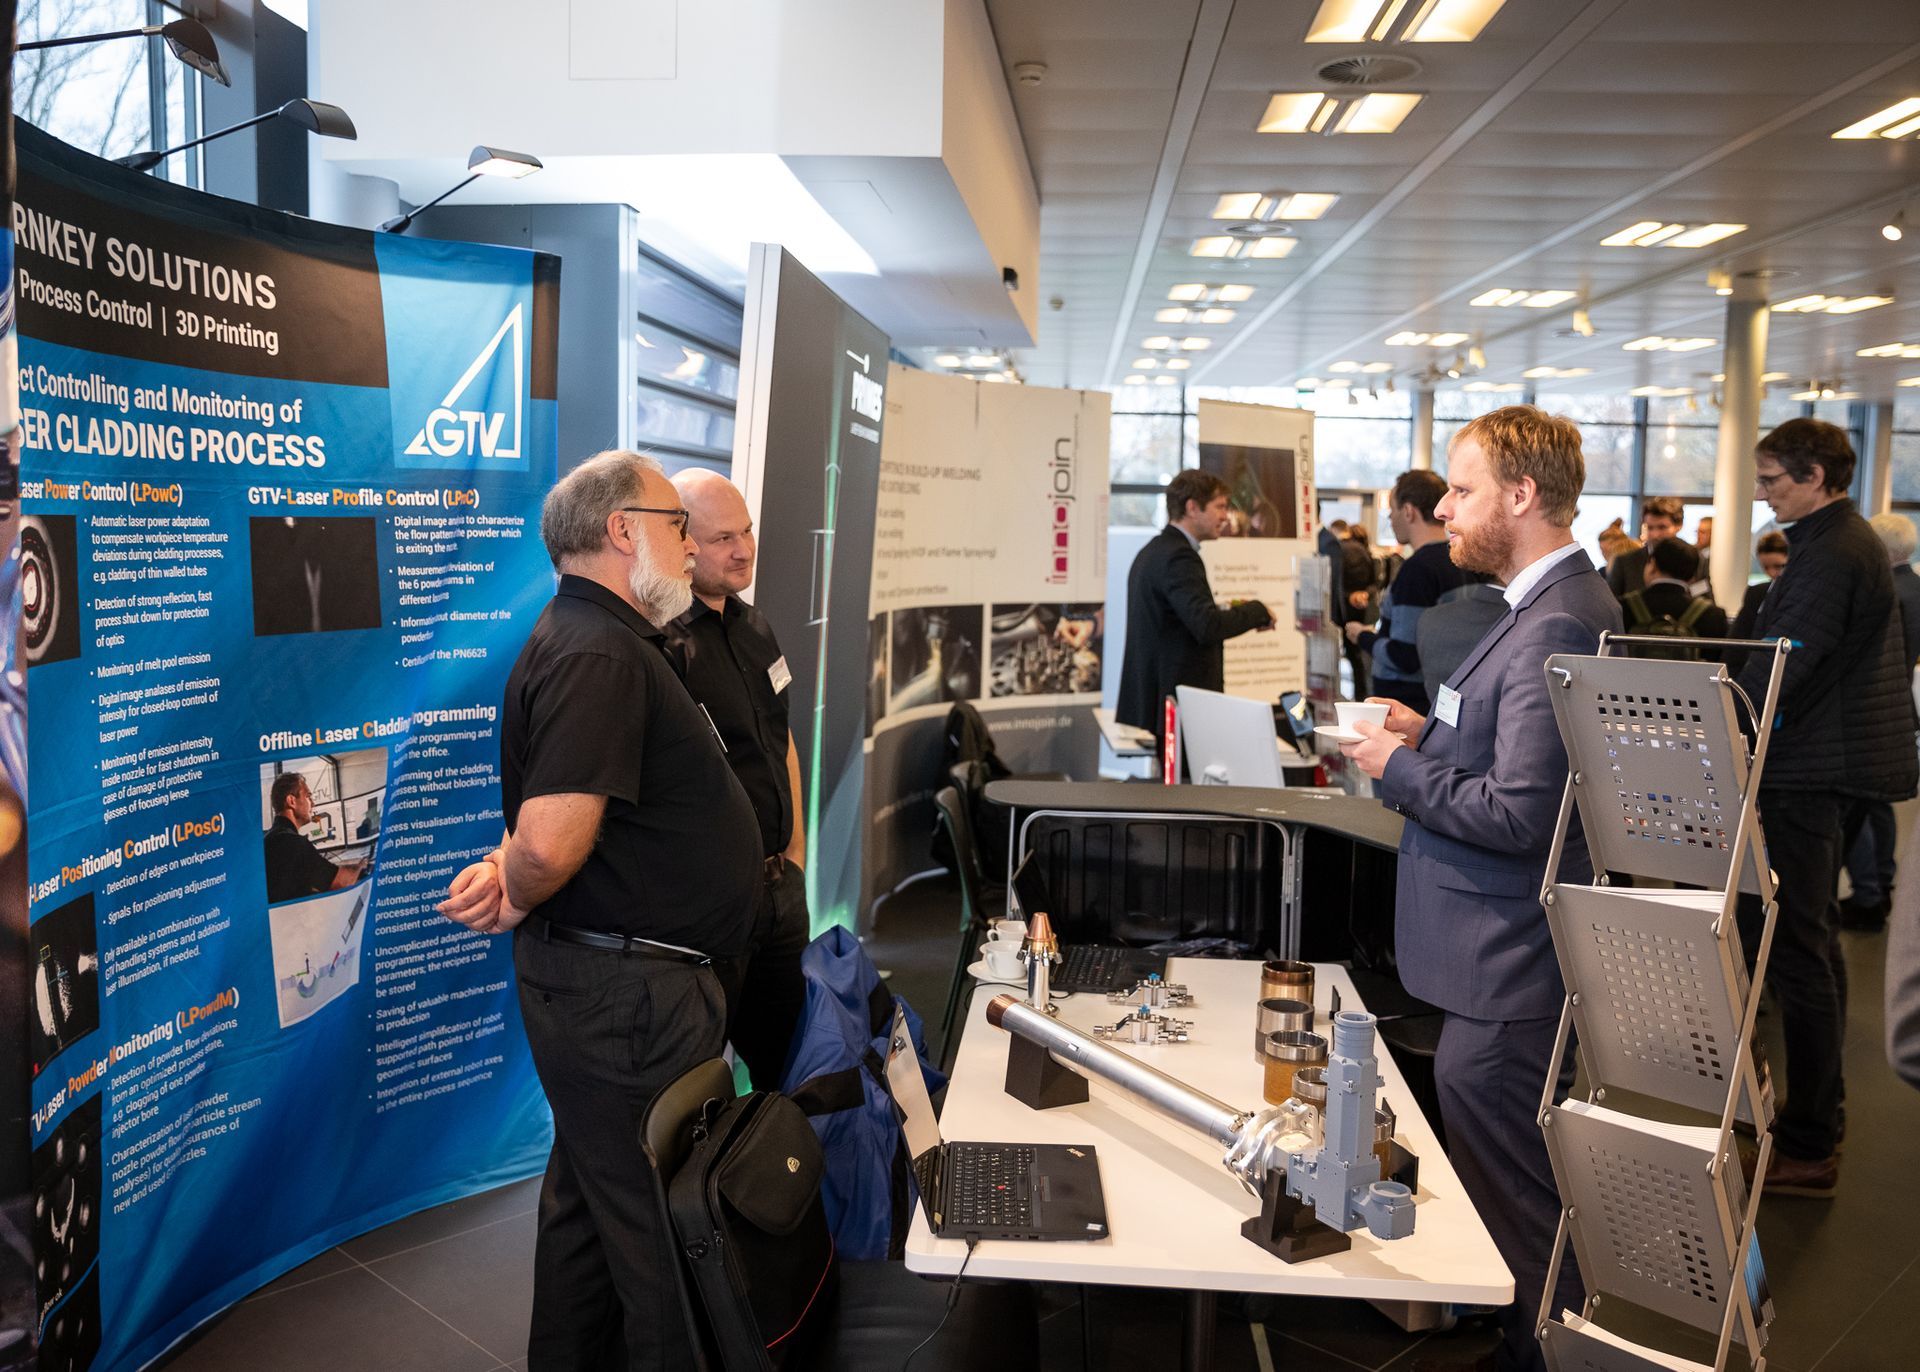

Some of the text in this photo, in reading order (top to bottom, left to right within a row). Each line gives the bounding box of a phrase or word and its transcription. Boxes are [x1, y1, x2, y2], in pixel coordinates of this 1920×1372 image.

[106, 237, 276, 310] SOLUTIONS
[20, 268, 152, 329] Process Control
[176, 310, 279, 356] 3D Printing
[36, 365, 129, 413] Controlling
[134, 385, 167, 411] and
[172, 386, 274, 427] Monitoring
[280, 399, 302, 424] of
[56, 416, 184, 461] CLADDING
[190, 428, 326, 468] PROCESS
[426, 408, 505, 457] GTV
[45, 479, 80, 499] Power
[82, 482, 127, 501] Control
[130, 482, 183, 508] (LPowC)
[248, 486, 440, 506] GTV-Laser Profile Control
[91, 515, 209, 529] Automatic laser power adaptation
[394, 516, 421, 528] Digital
[422, 516, 447, 528] image
[477, 515, 524, 526] characterize
[101, 533, 228, 546] compensate workpiece temperature
[395, 530, 409, 539] the
[411, 529, 429, 540] flow
[466, 529, 499, 539] powder
[501, 529, 521, 538] which
[93, 549, 224, 563] deviations during cladding processes,
[406, 544, 433, 555] exiting
[108, 566, 207, 582] cladding thin walled tubes
[398, 579, 412, 589] the
[95, 591, 212, 610] Detection strong reflection, fast
[399, 596, 432, 605] different
[95, 607, 209, 630] process shut down protection
[450, 611, 488, 621] diameter
[499, 610, 511, 619] the
[437, 649, 450, 659] the
[453, 648, 487, 659] PN6625
[97, 653, 211, 678] Monitoring emission
[185, 677, 220, 691] emission
[128, 695, 207, 717] for closed-loop control
[117, 726, 138, 741] power
[259, 730, 312, 752] Offline
[315, 725, 359, 744] Laser
[419, 728, 492, 744] programming and
[101, 736, 212, 771] Monitoring emission intensity
[121, 753, 210, 783] nozzle for fast shutdown
[445, 764, 493, 776] the cladding
[127, 770, 202, 797] damage protective
[420, 777, 486, 792] without blocking
[138, 794, 168, 810] focusing
[422, 798, 438, 806] line
[411, 813, 475, 829] visualisation for
[62, 813, 225, 887] Positioning Control (LPosC)
[395, 834, 433, 848] planning
[149, 848, 224, 879] edges workpieces
[429, 850, 470, 862] interfering
[405, 866, 453, 881] deployment
[132, 873, 226, 912] for positioning adjustment
[376, 895, 420, 907] Automatic
[375, 906, 419, 922] processes
[116, 914, 205, 953] available combination
[375, 921, 420, 935] consistent
[116, 917, 230, 971] handling systems and additional
[375, 936, 439, 956] Uncomplicated
[375, 939, 490, 971] programme sets and coating
[428, 963, 441, 971] the
[442, 956, 470, 969] recipes
[389, 982, 416, 996] stored
[376, 980, 507, 1018] Saving valuable machine costs
[387, 1012, 430, 1030] production
[376, 1023, 471, 1053] Intelligent simplification
[376, 1023, 504, 1065] supported path points different
[156, 1044, 183, 1068] powder
[417, 1053, 452, 1066] surfaces
[68, 1057, 108, 1098] Powder
[141, 1061, 177, 1090] optimized
[377, 1067, 463, 1098] Integration external
[126, 1078, 183, 1114] clogging one
[398, 1084, 455, 1105] entire process
[228, 1097, 261, 1115] stream
[112, 1123, 173, 1165] Characterization
[152, 1161, 162, 1174] for
[132, 1186, 148, 1203] and
